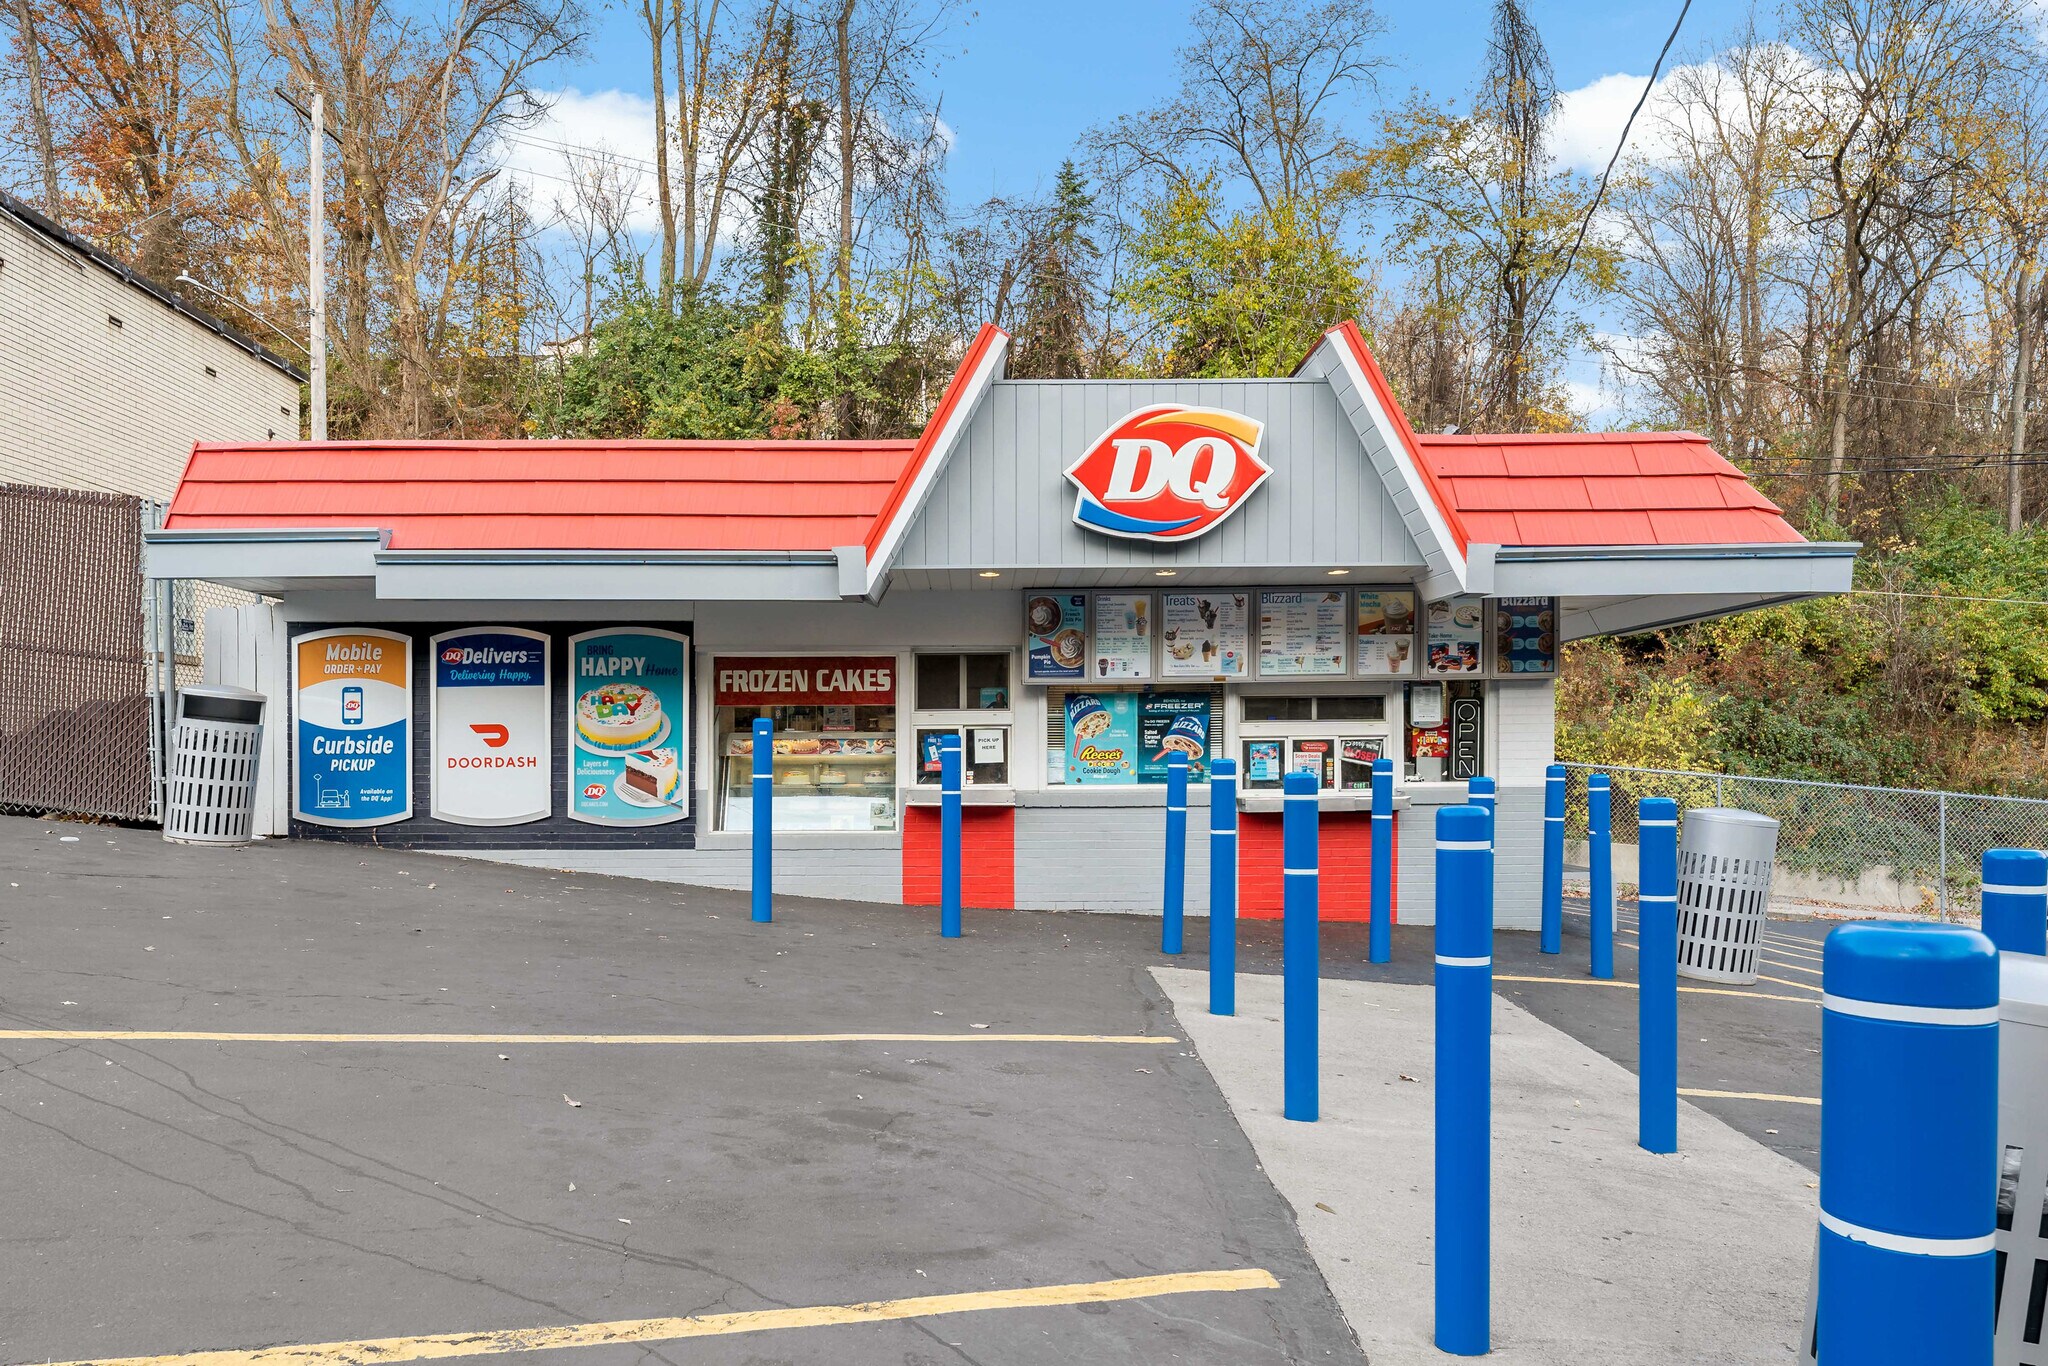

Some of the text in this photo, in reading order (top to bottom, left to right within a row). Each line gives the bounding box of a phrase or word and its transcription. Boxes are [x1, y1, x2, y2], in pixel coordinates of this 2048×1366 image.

[1103, 437, 1230, 509] DQ
[1164, 594, 1196, 606] Treats
[1261, 592, 1302, 604] Blizzard
[1360, 592, 1379, 600] White
[1501, 596, 1549, 606] Blizzard
[325, 642, 383, 661] Mobile
[445, 647, 528, 665] DQ Delivers
[587, 645, 614, 655] BRING
[324, 664, 355, 674] ORDER
[363, 664, 383, 674] PAY
[581, 656, 646, 676] HAPPY
[645, 663, 679, 676] Home
[450, 669, 496, 683] Delivering
[719, 669, 892, 693] FROZEN CAKES
[590, 693, 647, 706] HAPPY
[595, 702, 643, 719] DAY
[1170, 720, 1206, 739] BLIZZARD
[312, 734, 394, 755] Curbside
[1457, 703, 1476, 776] OPEN
[1080, 746, 1123, 760] Reese's
[1344, 747, 1378, 762] CLOSED
[330, 759, 376, 772] PICKUP
[447, 756, 537, 769] DOORDASH
[583, 759, 609, 769] Layers of
[576, 768, 616, 776] Deliciousness
[1102, 767, 1121, 775] Dough
[587, 787, 604, 796] DQ
